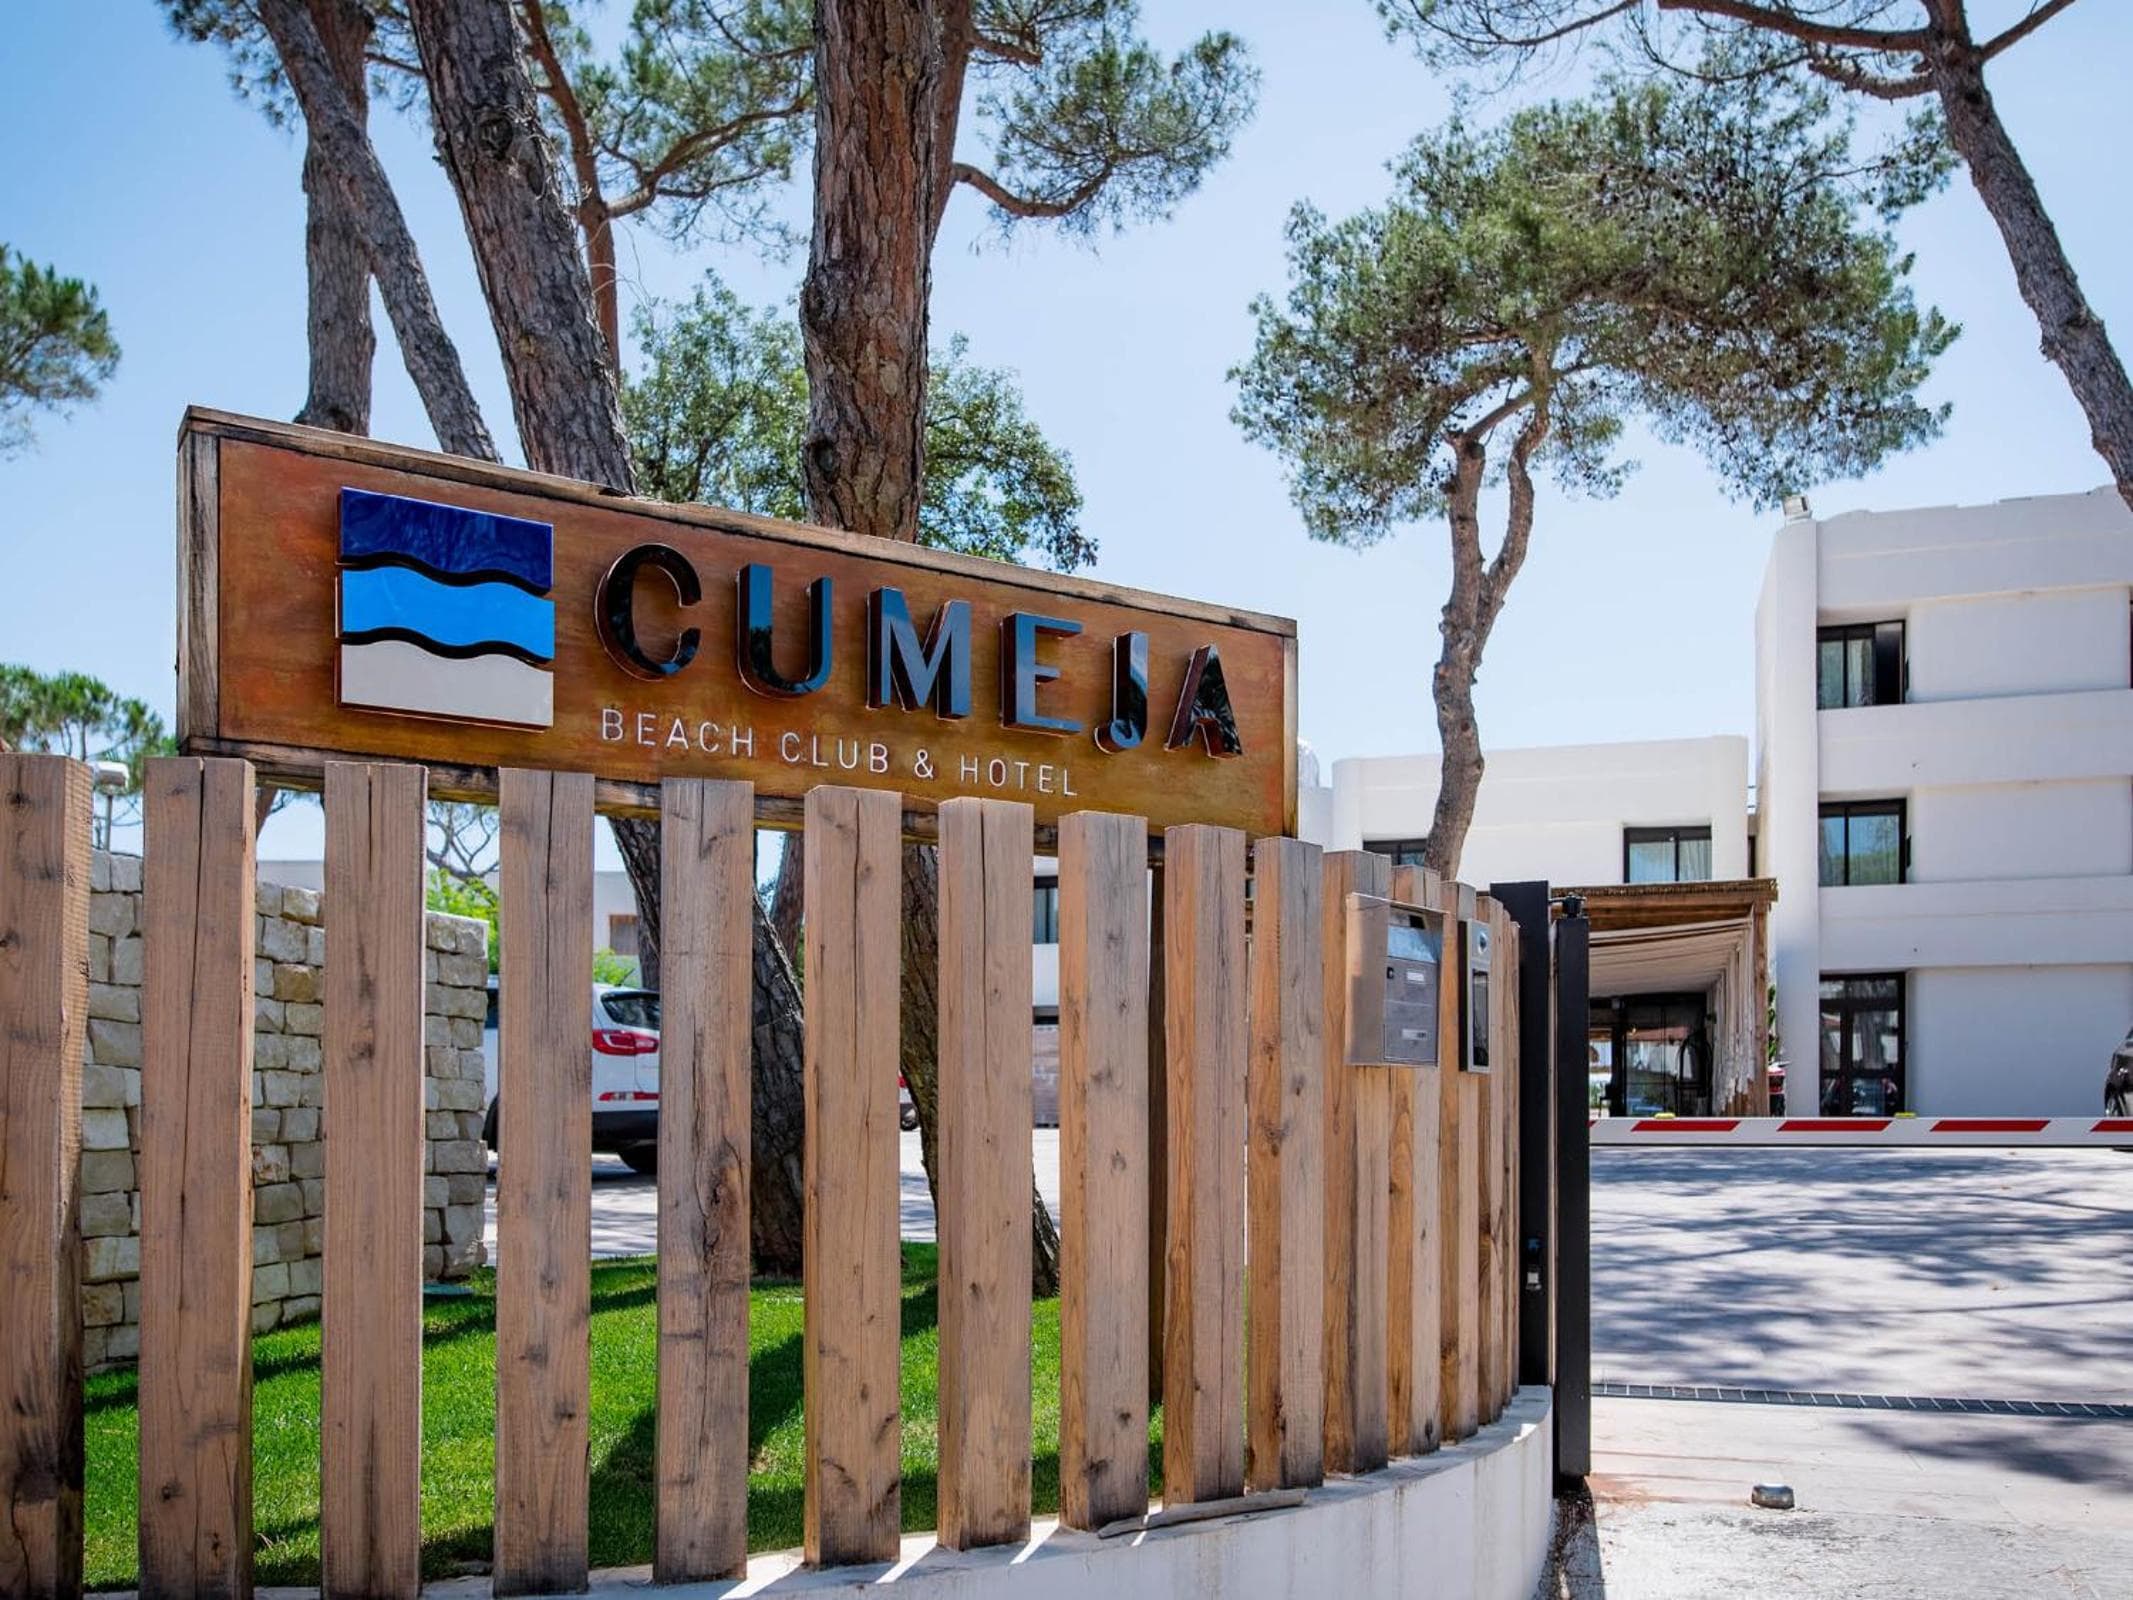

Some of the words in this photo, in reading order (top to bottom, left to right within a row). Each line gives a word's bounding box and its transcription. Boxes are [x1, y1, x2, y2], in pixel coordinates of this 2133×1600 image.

[595, 543, 1242, 758] CUMEJA
[602, 708, 754, 757] BEACH
[780, 731, 888, 774] CLUB
[914, 748, 934, 779] &
[960, 754, 1078, 797] HOTEL
